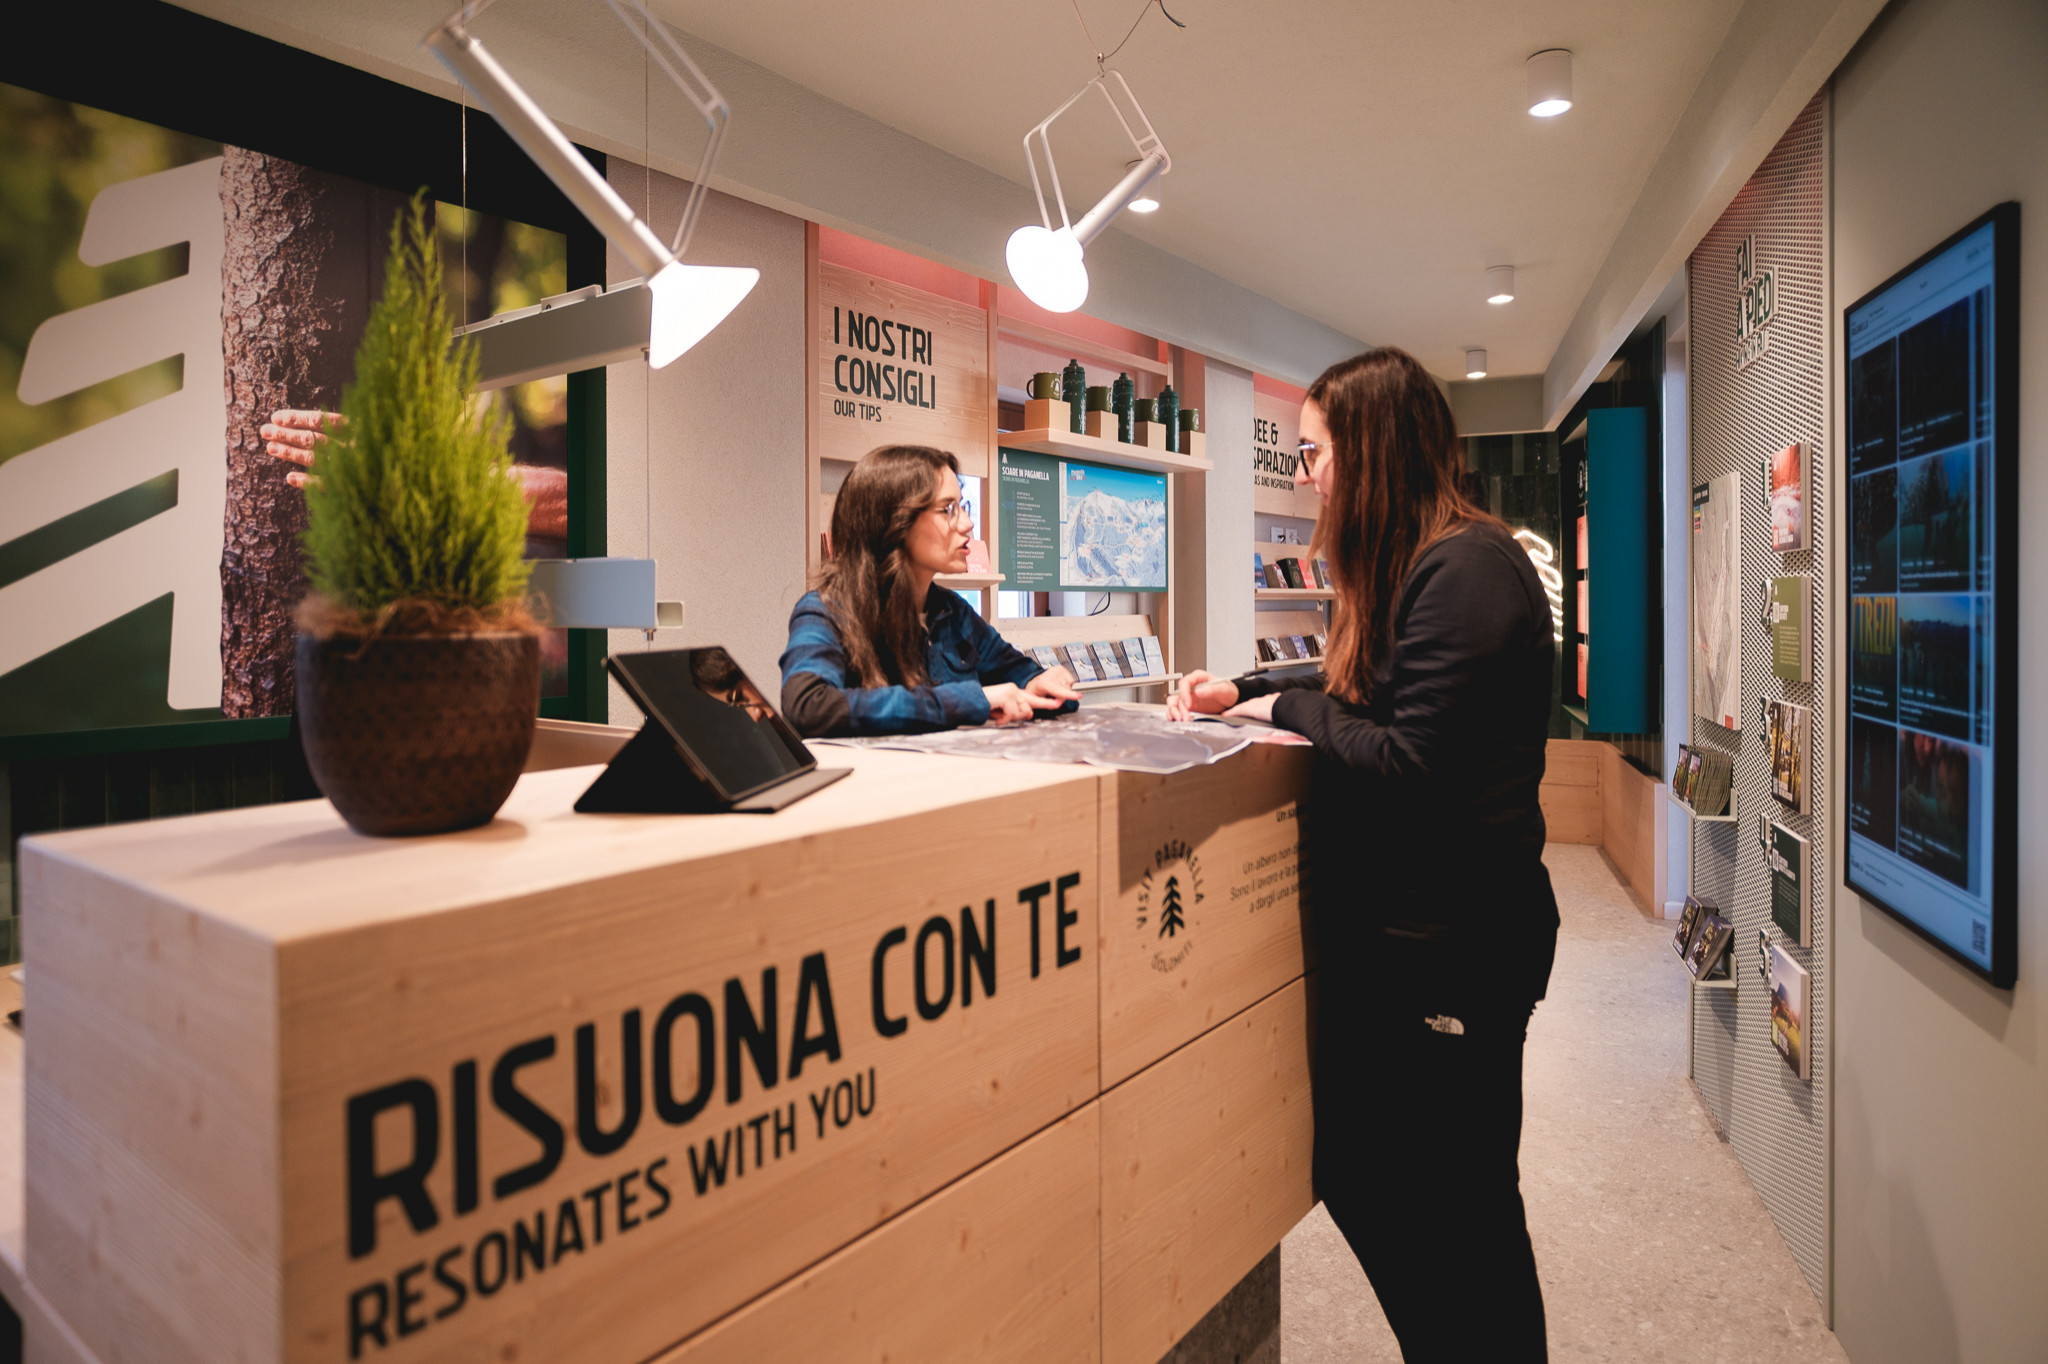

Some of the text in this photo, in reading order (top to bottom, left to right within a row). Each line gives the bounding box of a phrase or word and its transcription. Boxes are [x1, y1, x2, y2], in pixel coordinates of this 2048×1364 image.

[1736, 233, 1752, 291] FAI
[1736, 266, 1775, 343] A PIEDI
[834, 306, 932, 366] I NOSTRI
[834, 354, 936, 410] CONSIGLI
[834, 398, 882, 422] OUR TIPS
[1271, 422, 1278, 445] &
[1002, 466, 1049, 481] SCIARE IN PAGANELLA
[345, 871, 1082, 1262] RISUONA CON TE
[347, 1066, 876, 1361] RESONATES WITH YOU
